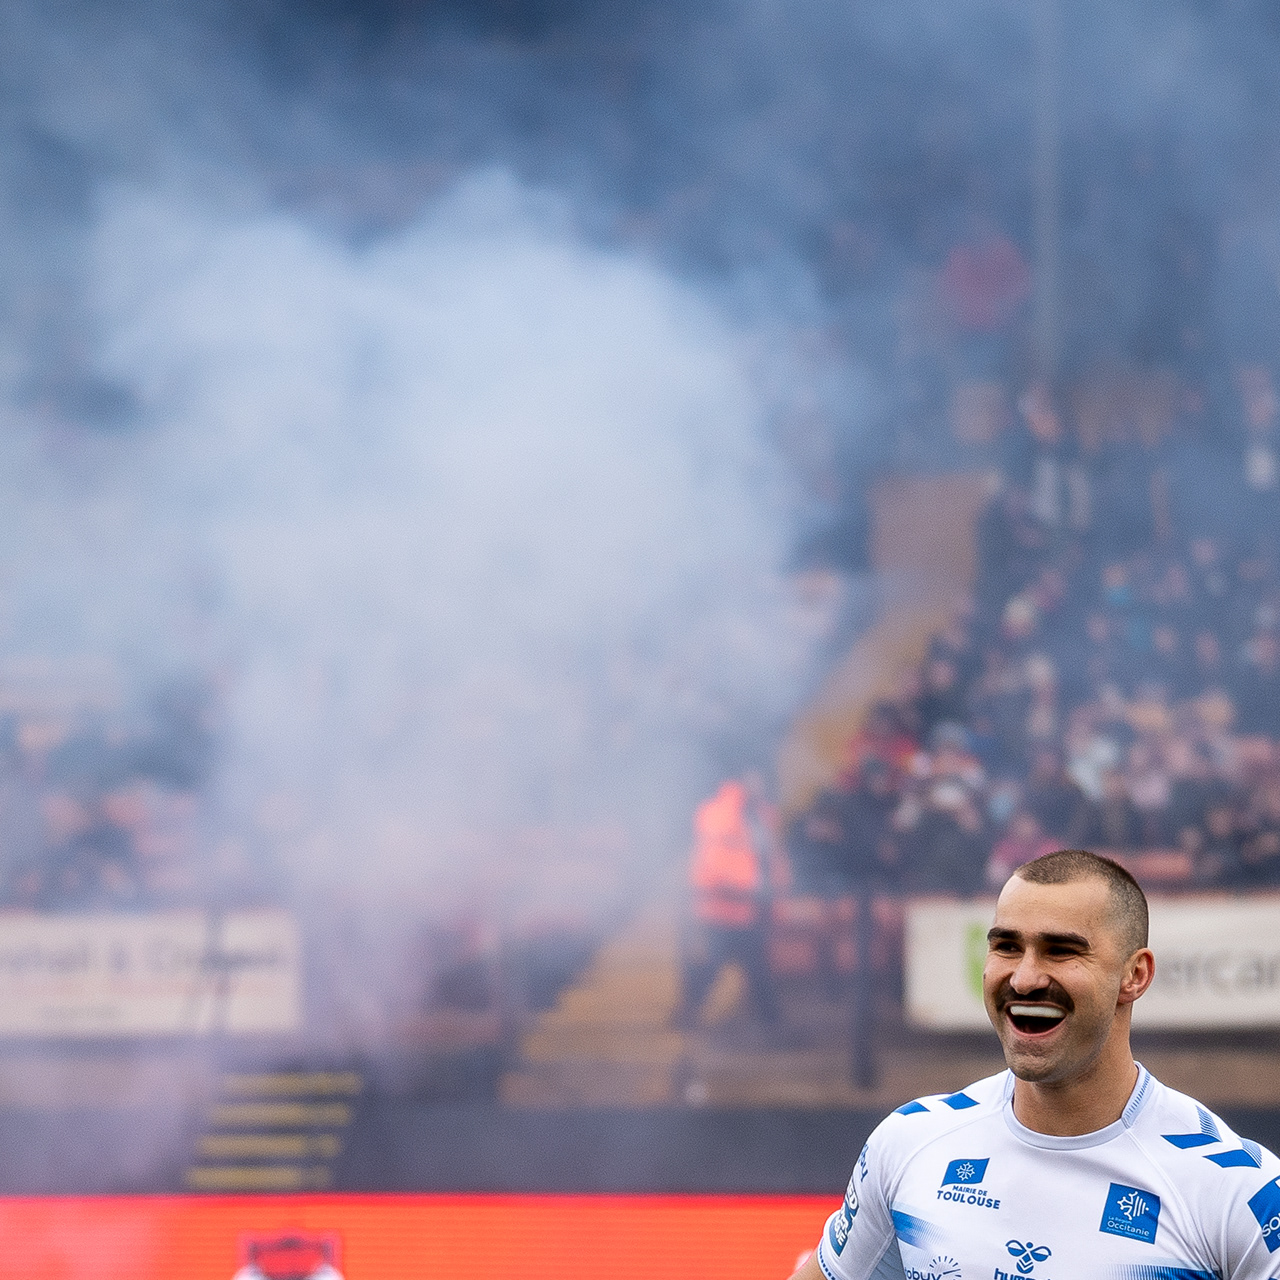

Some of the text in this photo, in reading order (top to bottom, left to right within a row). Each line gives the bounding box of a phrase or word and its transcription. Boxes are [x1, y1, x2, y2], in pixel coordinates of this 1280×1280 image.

[952, 1185, 976, 1195] MAIRIE
[937, 1190, 1001, 1209] TOULOUSE
[1107, 1220, 1150, 1237] Occitanie
